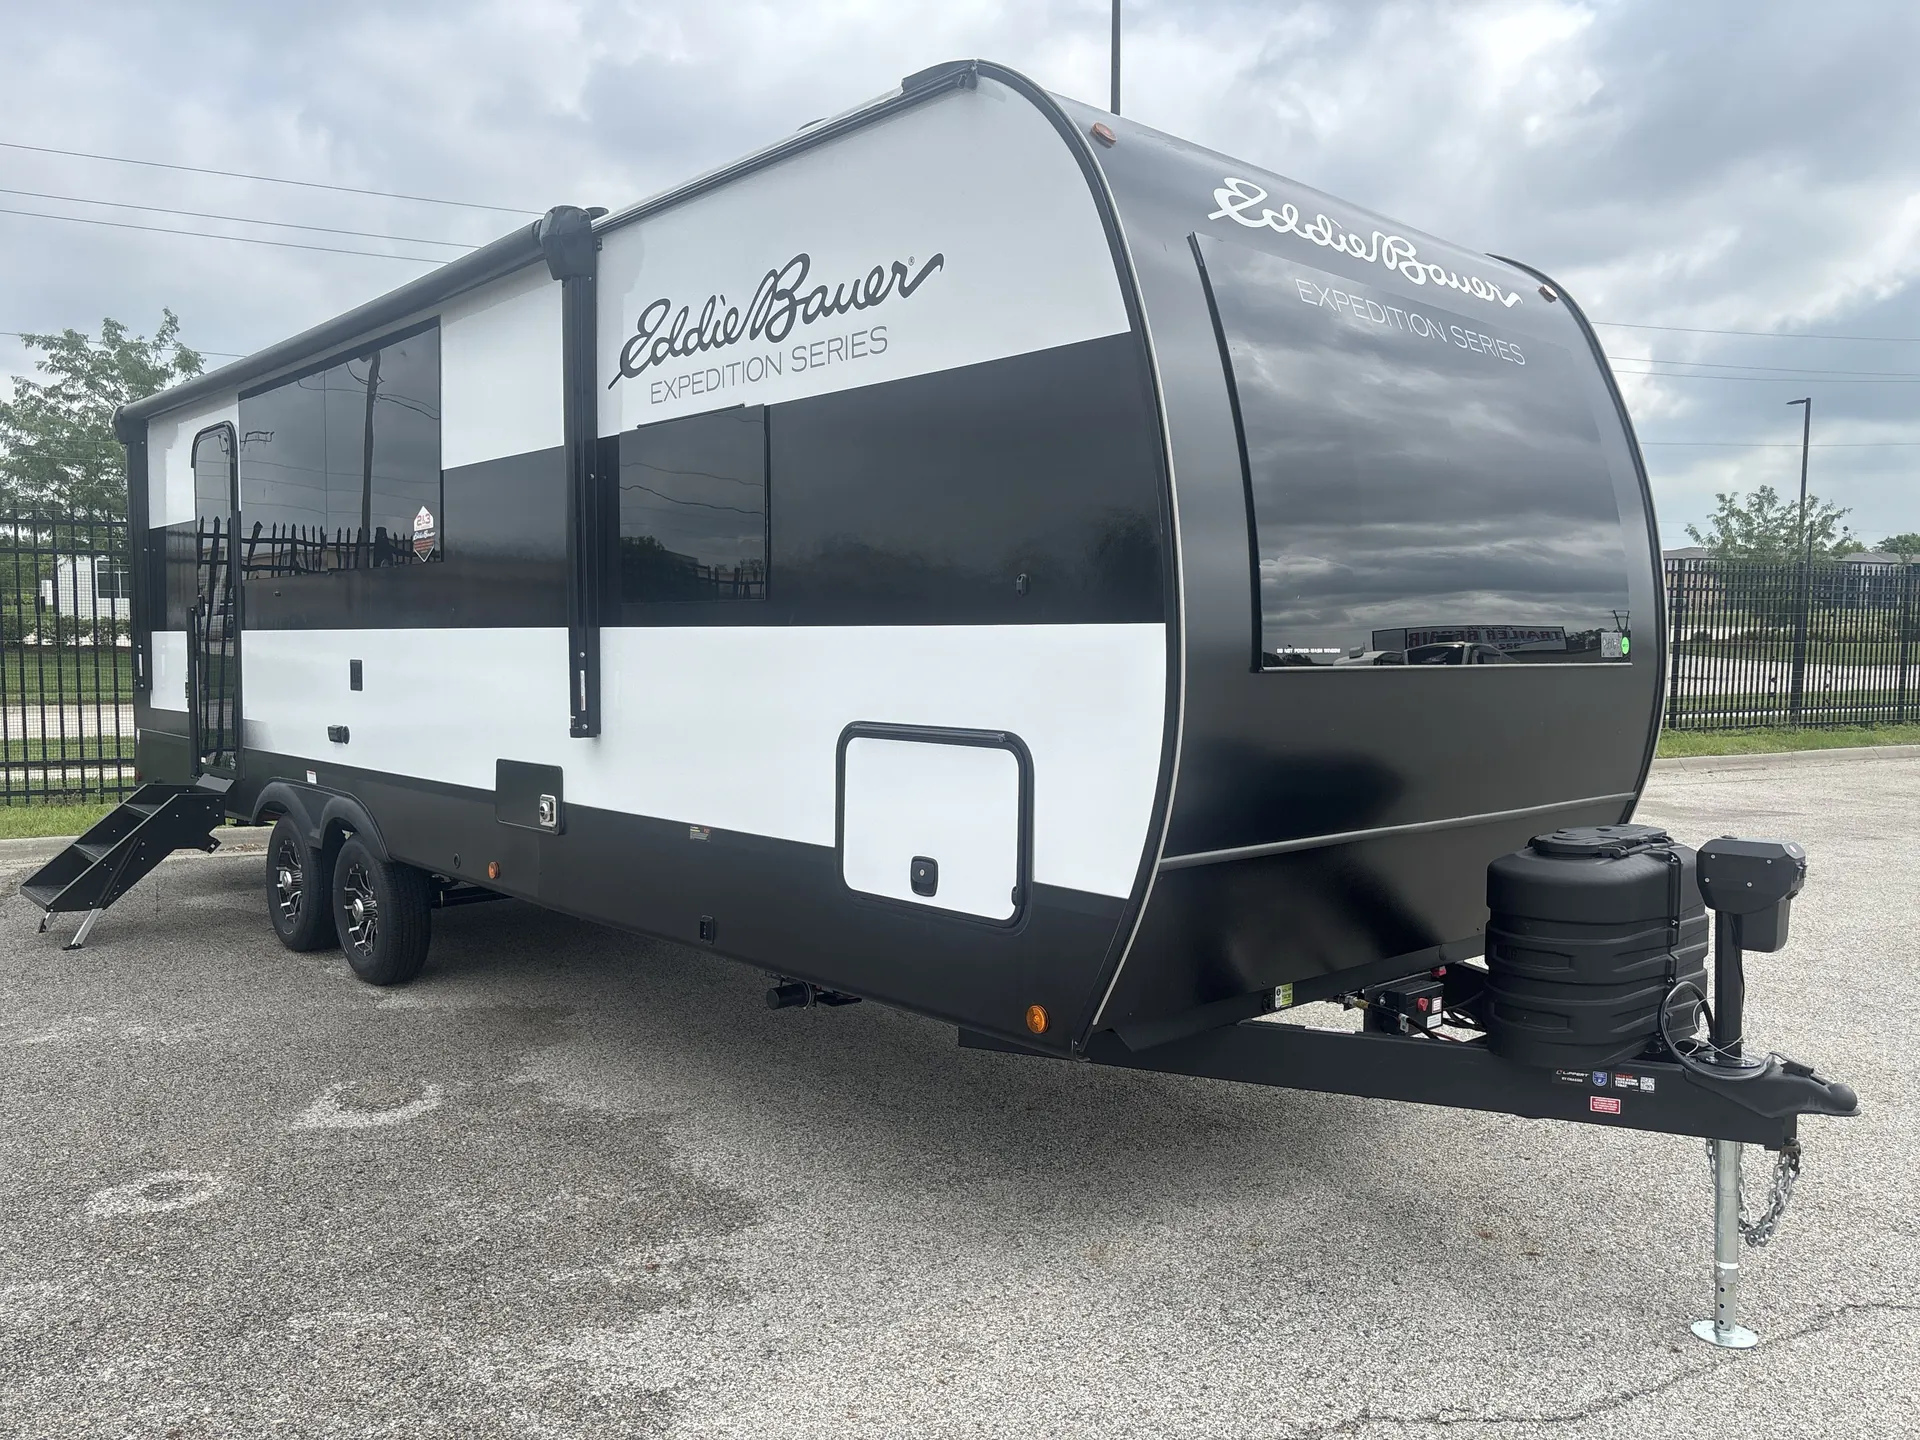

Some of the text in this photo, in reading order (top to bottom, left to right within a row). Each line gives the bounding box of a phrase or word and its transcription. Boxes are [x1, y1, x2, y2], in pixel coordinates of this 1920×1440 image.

[1208, 177, 1523, 307] Eddie Bauer
[608, 253, 944, 390] Eddie Bauer
[651, 325, 889, 404] EXPEDITION SERIES
[1295, 278, 1526, 366] EXPEDITION SERIES
